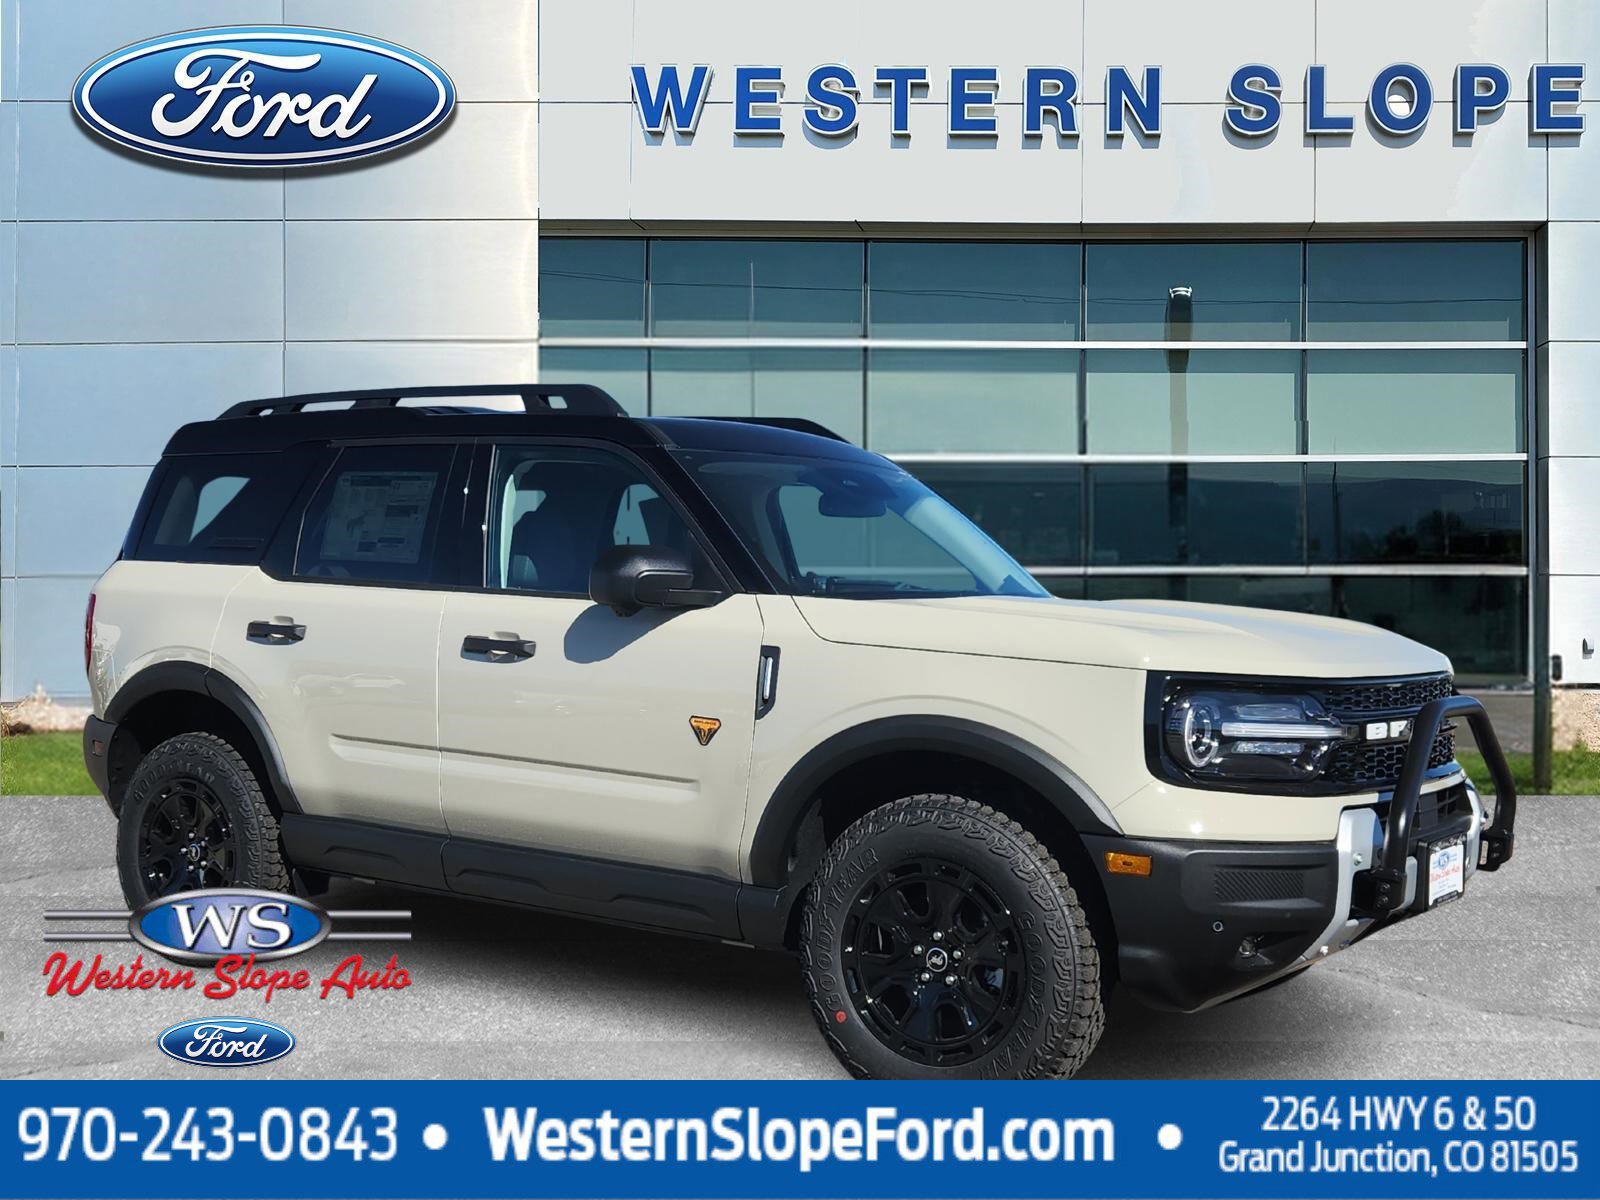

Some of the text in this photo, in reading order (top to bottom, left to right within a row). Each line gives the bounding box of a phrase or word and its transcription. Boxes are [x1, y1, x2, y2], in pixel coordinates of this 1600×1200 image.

[150, 48, 379, 140] Ford
[630, 62, 1586, 137] WESTERN SLOPE
